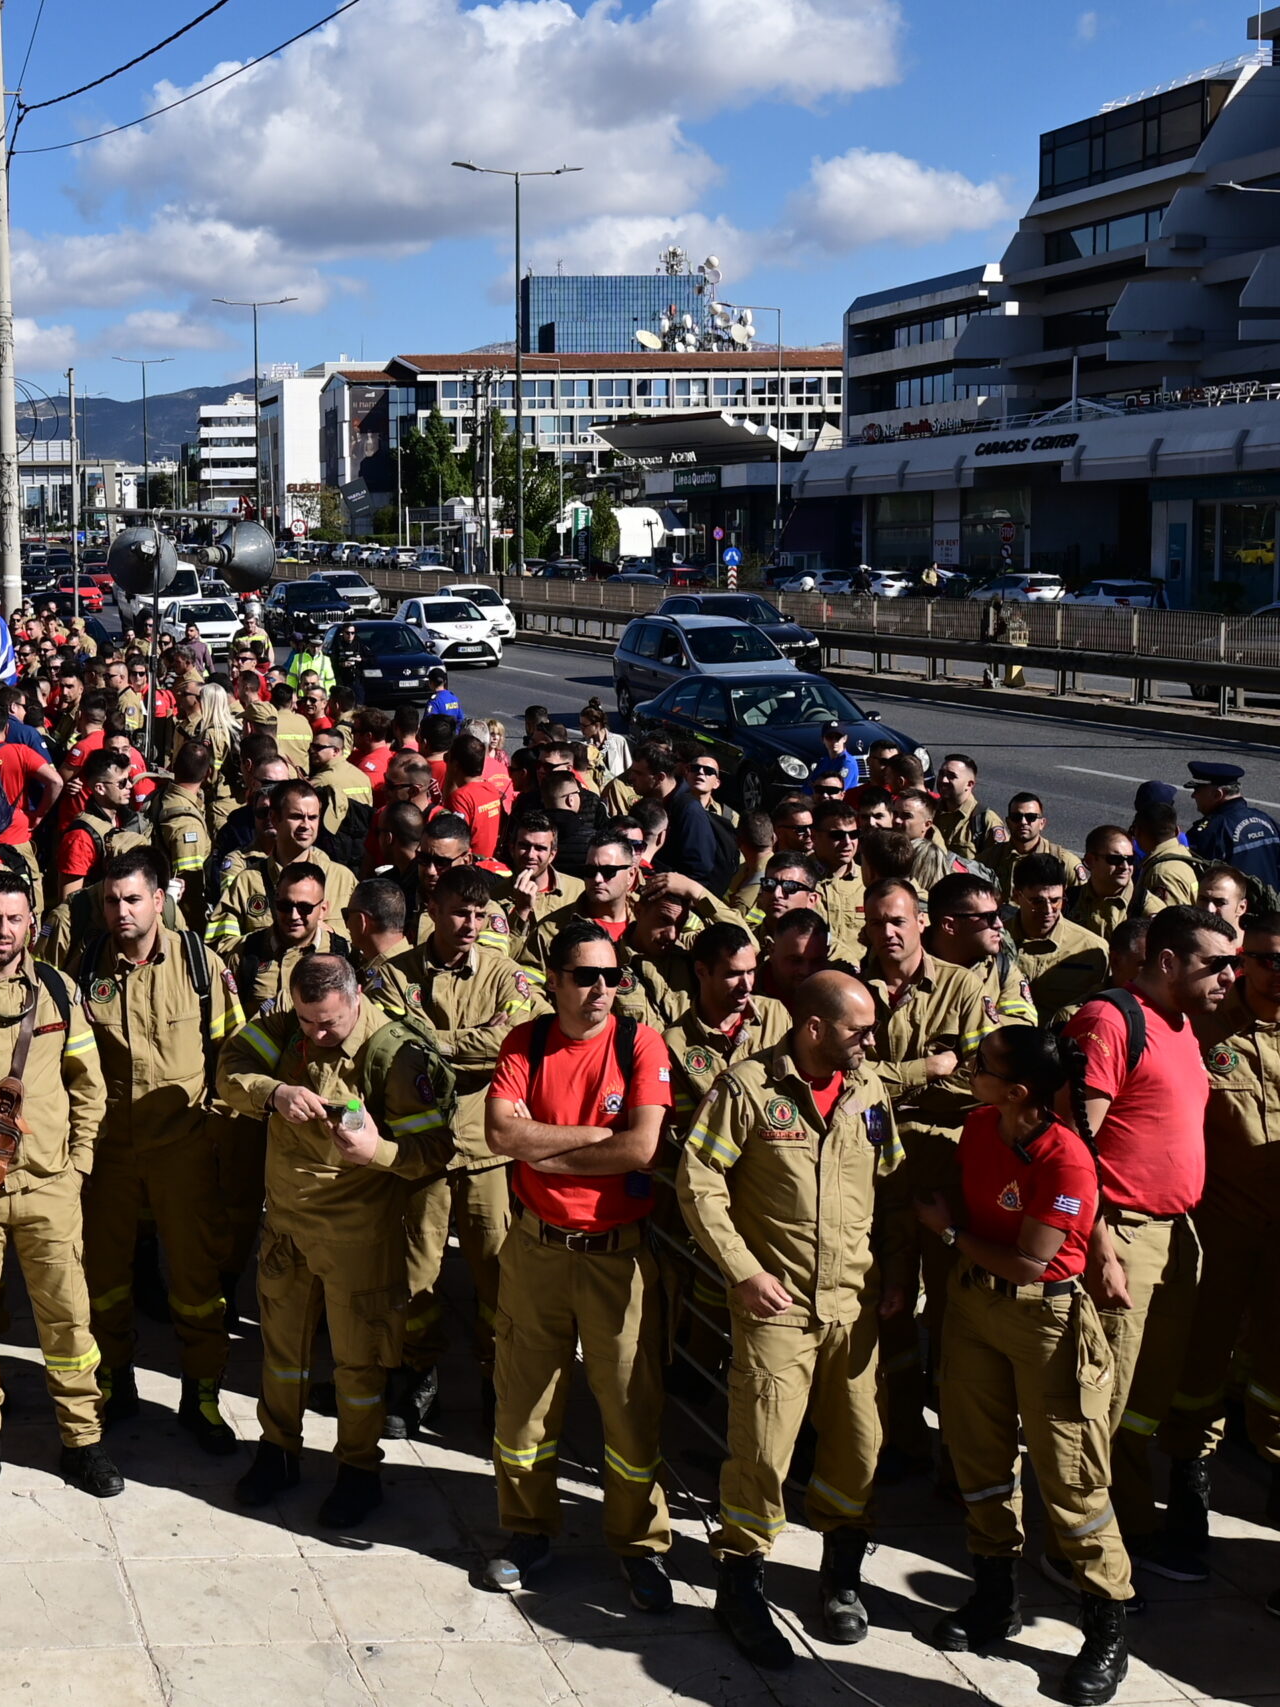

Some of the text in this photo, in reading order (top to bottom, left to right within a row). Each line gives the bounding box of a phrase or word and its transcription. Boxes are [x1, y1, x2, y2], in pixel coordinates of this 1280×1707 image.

[975, 433, 1079, 456] CARACAS CENTER
[1001, 527, 1014, 538] STOP
[1247, 831, 1265, 839] POLICE
